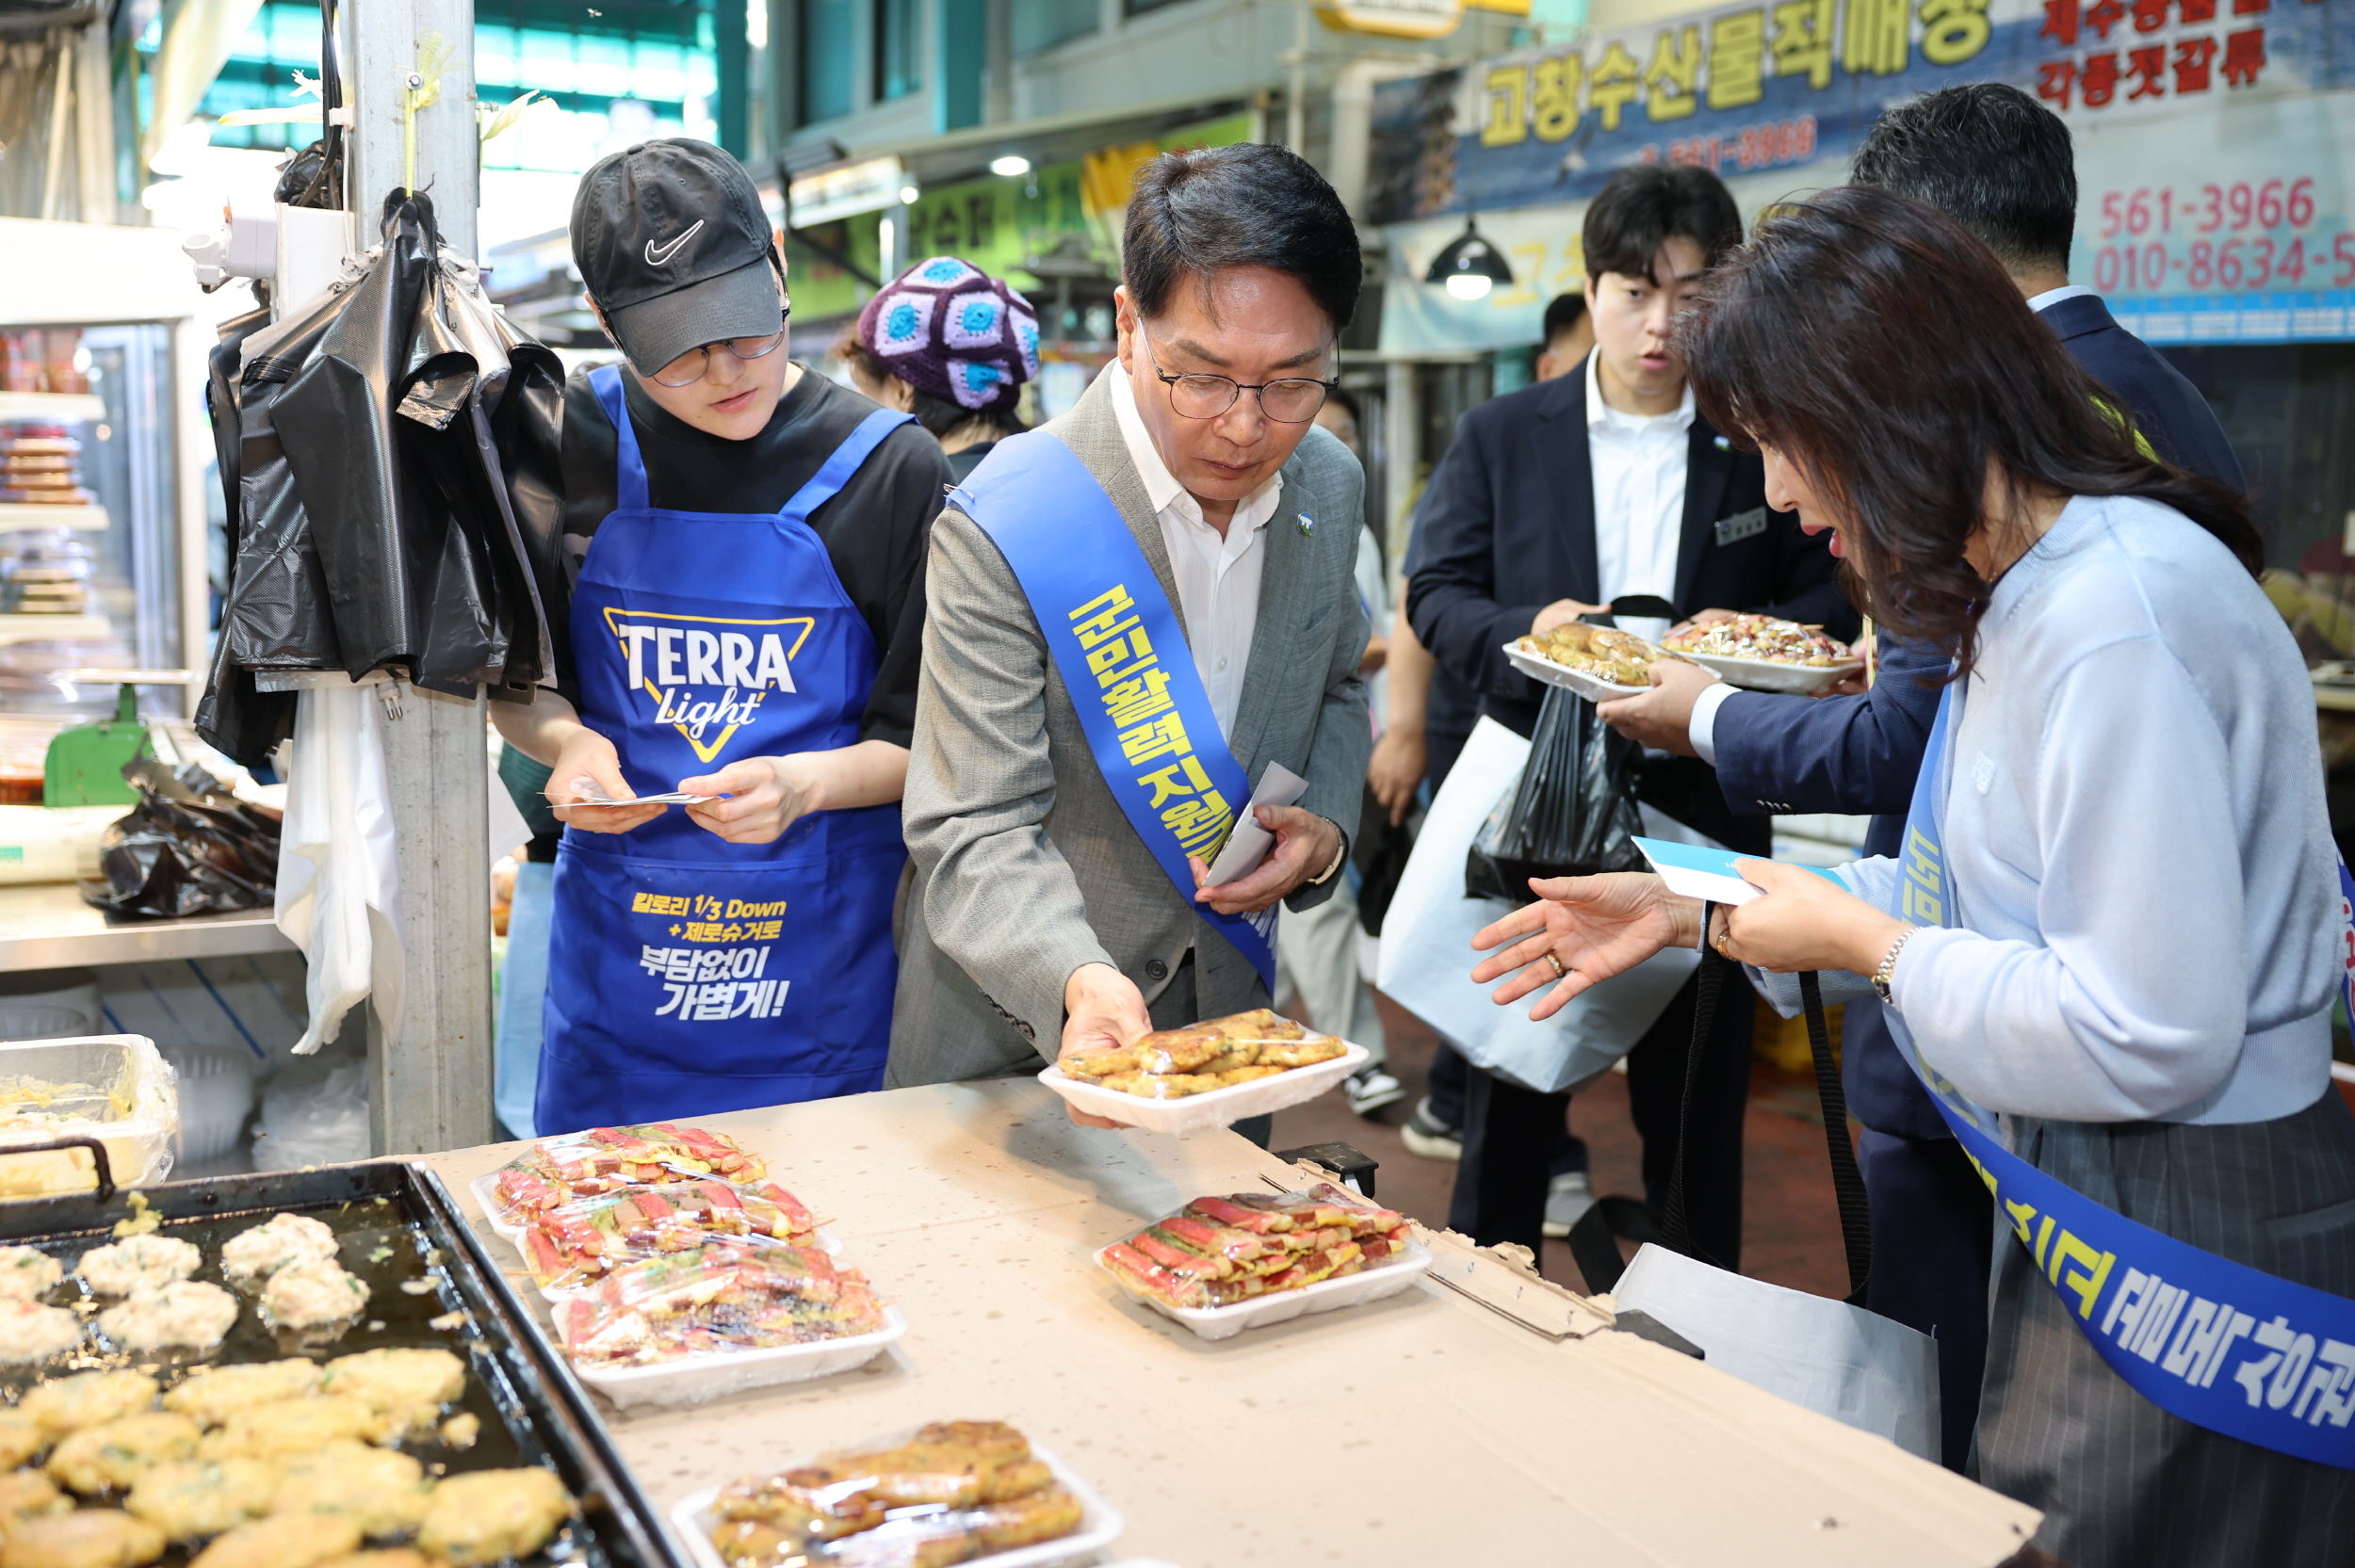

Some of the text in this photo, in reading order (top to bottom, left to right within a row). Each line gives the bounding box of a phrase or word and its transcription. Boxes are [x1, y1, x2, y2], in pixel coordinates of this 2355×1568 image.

[2100, 176, 2316, 239] 561-3966
[618, 622, 798, 694] TERRA
[654, 686, 761, 740] Light
[631, 891, 788, 921] 칼로리 1/3 Down
[639, 944, 771, 982] 부담없이
[654, 979, 790, 1022] 가볍게!
